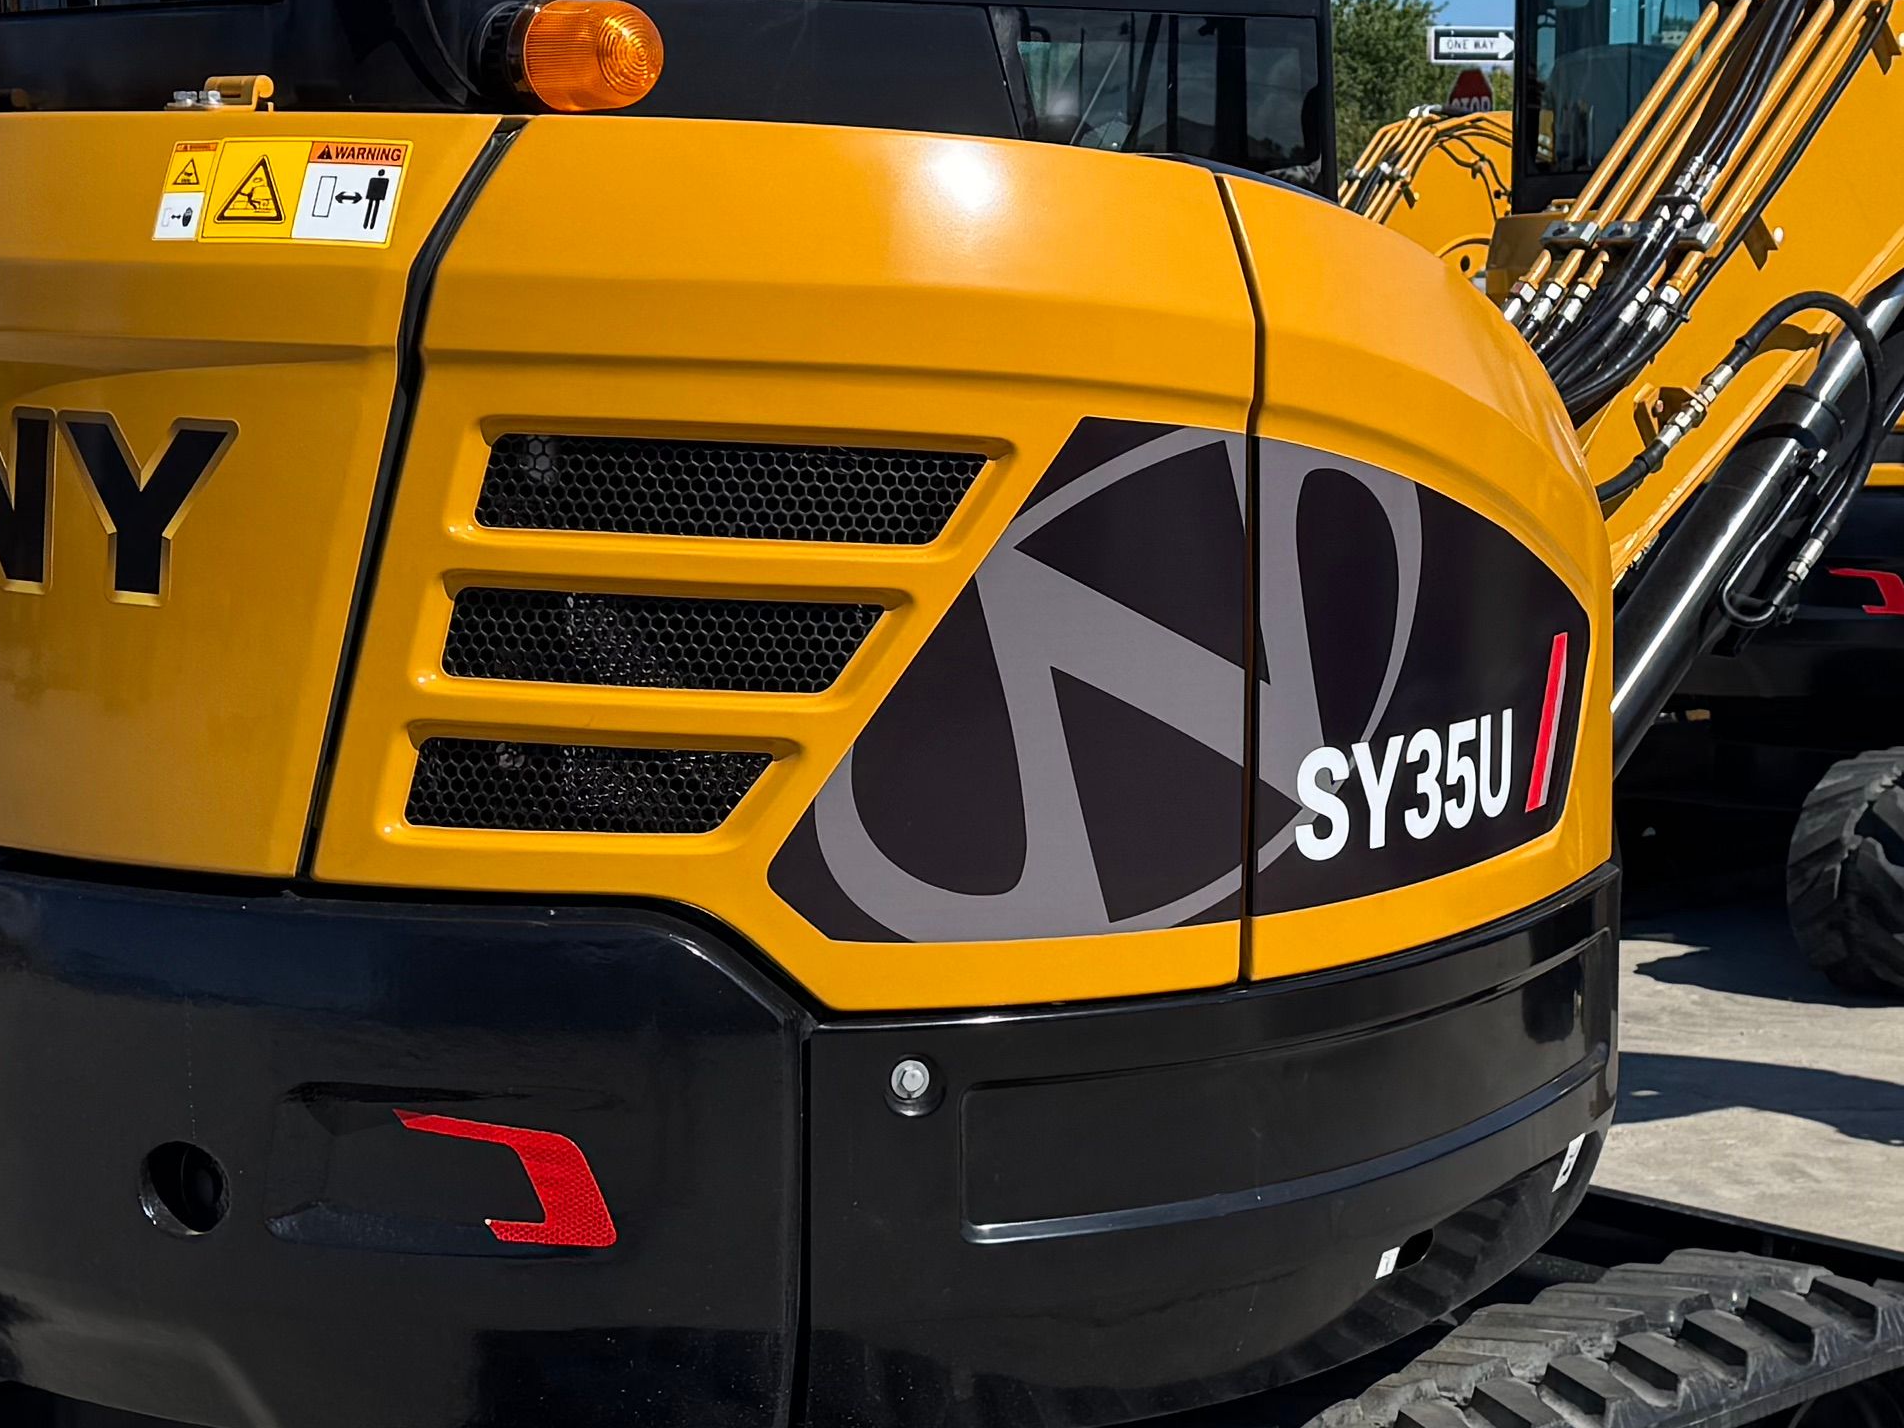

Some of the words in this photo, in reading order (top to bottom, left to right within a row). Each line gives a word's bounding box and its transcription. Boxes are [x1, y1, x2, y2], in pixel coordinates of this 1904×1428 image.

[1447, 39, 1468, 50] ONE
[1473, 39, 1495, 50] WAY
[335, 146, 402, 161] WARNING
[1296, 708, 1513, 861] SY35U
